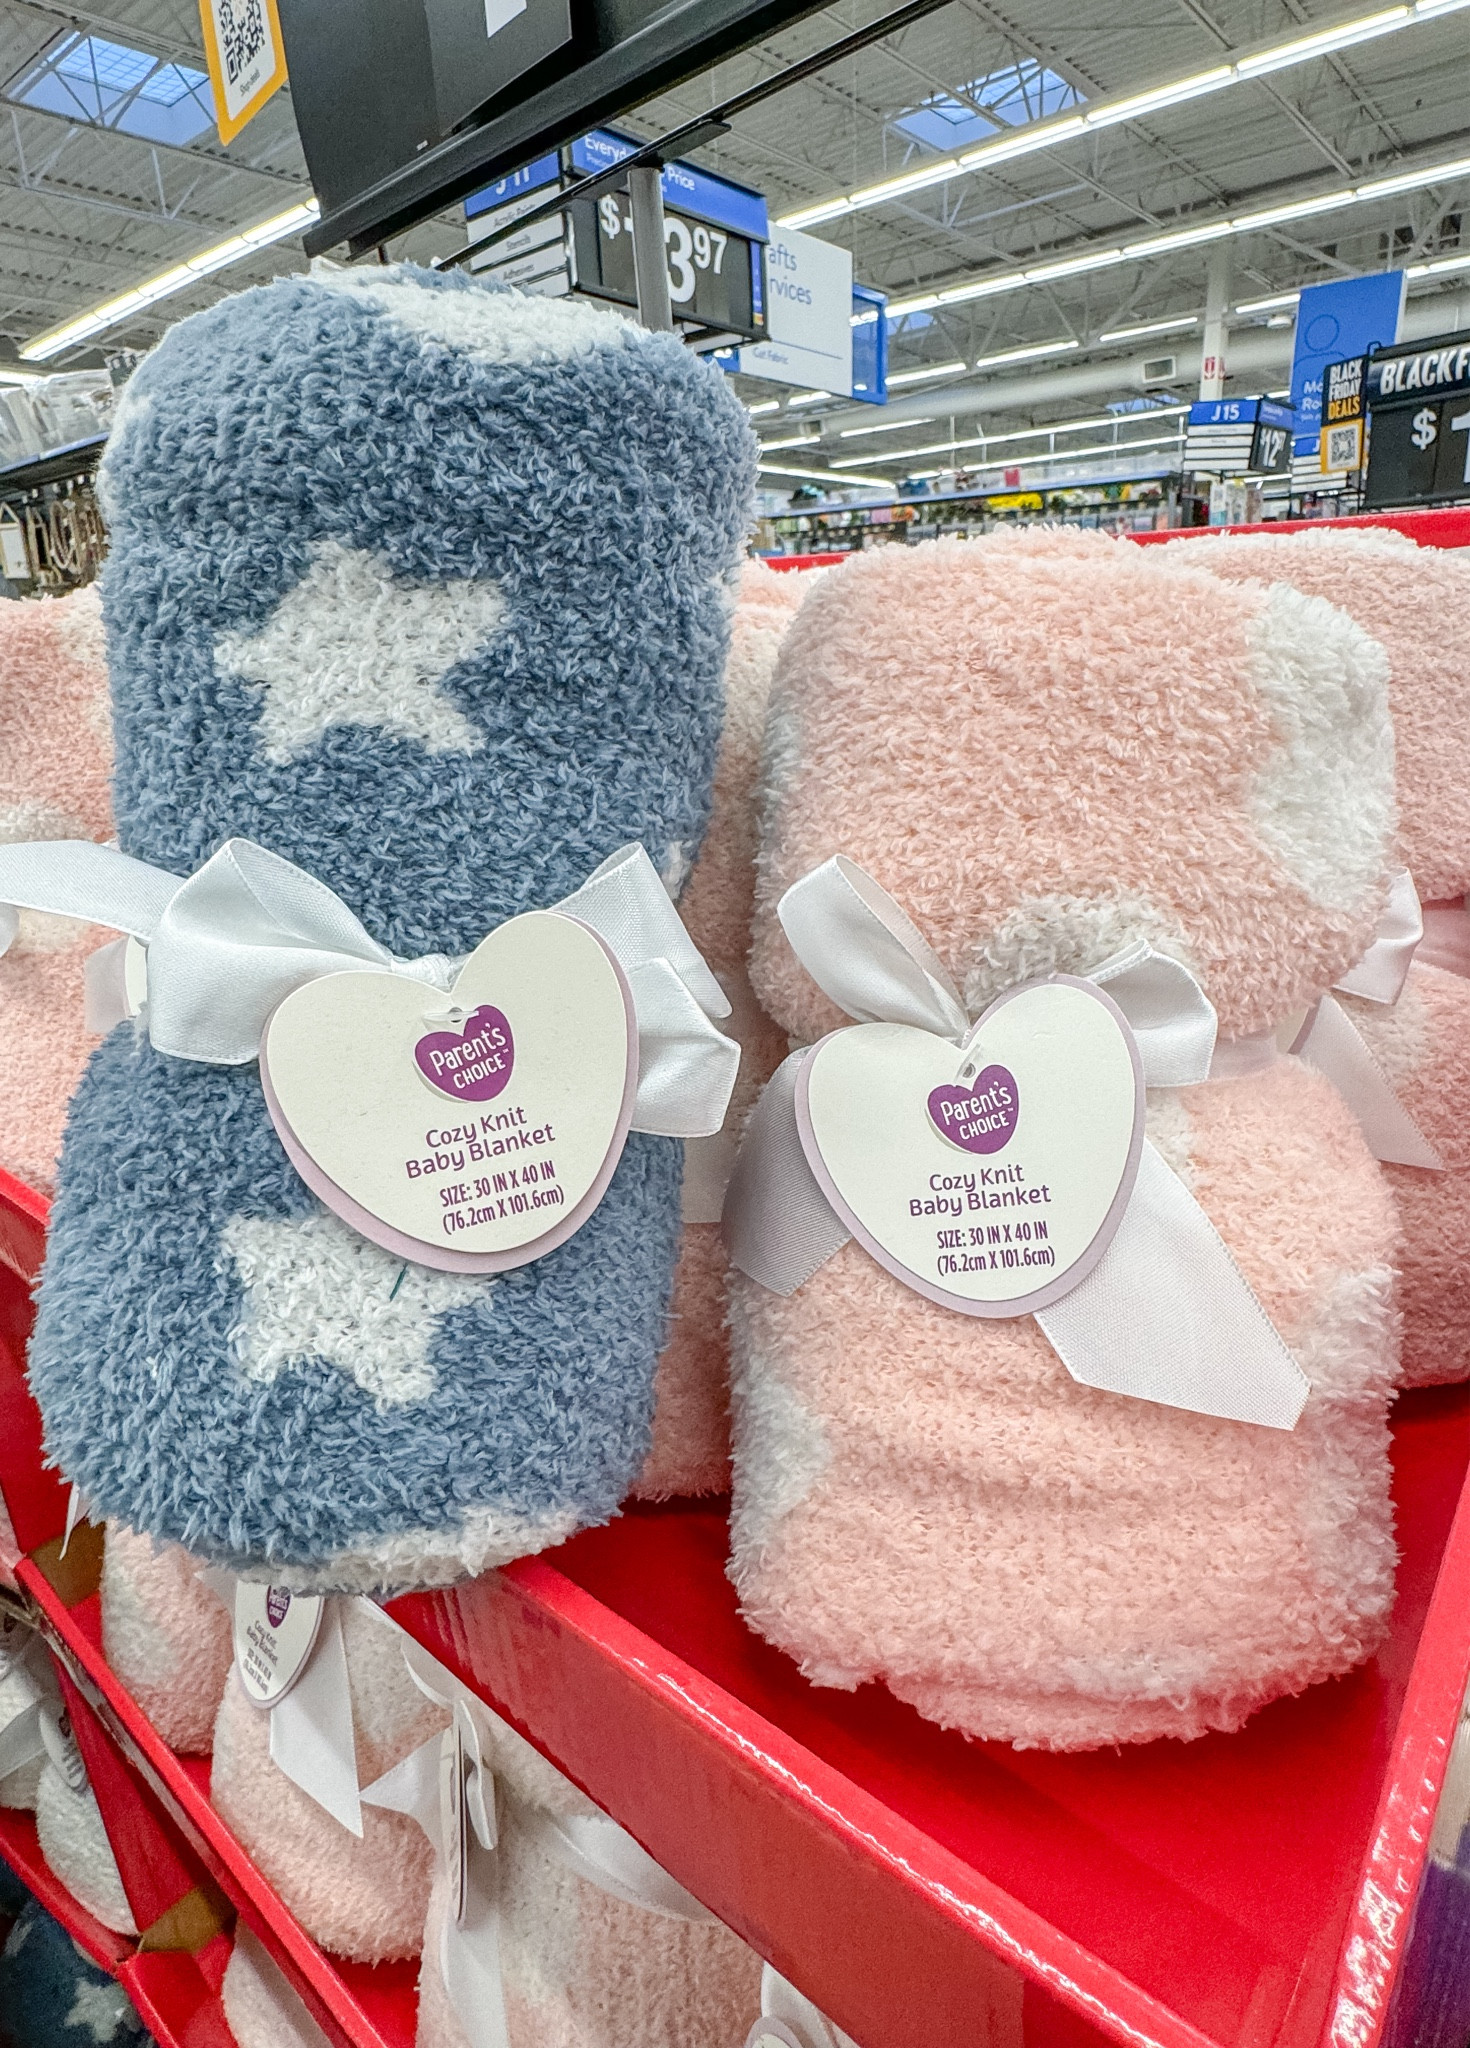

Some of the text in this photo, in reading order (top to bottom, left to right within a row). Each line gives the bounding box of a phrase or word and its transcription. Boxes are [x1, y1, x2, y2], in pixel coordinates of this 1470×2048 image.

[667, 165, 695, 191] Price
[768, 243, 797, 271] afts
[769, 277, 812, 305] rvices
[1330, 359, 1363, 384] BLACK
[1329, 379, 1362, 402] FRIDAY
[1211, 404, 1239, 421] J 15
[1328, 395, 1360, 420] DEALS
[429, 1022, 506, 1076] Parent's
[453, 1053, 506, 1089] CHOICE
[940, 1081, 1012, 1126] Parent's
[426, 1106, 527, 1148] Cozy Knit
[959, 1111, 1009, 1140] CHOICE
[406, 1123, 556, 1179] Baby Blanket
[440, 1160, 556, 1207] SIZE: 30 IN X 40 IN
[929, 1164, 1025, 1192] Cozy Knit
[442, 1184, 564, 1235] (76.2cm X 101.6cm)
[909, 1184, 1051, 1217] Baby Blanket
[936, 1220, 1049, 1249] SIZE: 30 IN X 40 IN
[937, 1245, 1055, 1277] (76.2cm X 101.6cm)
